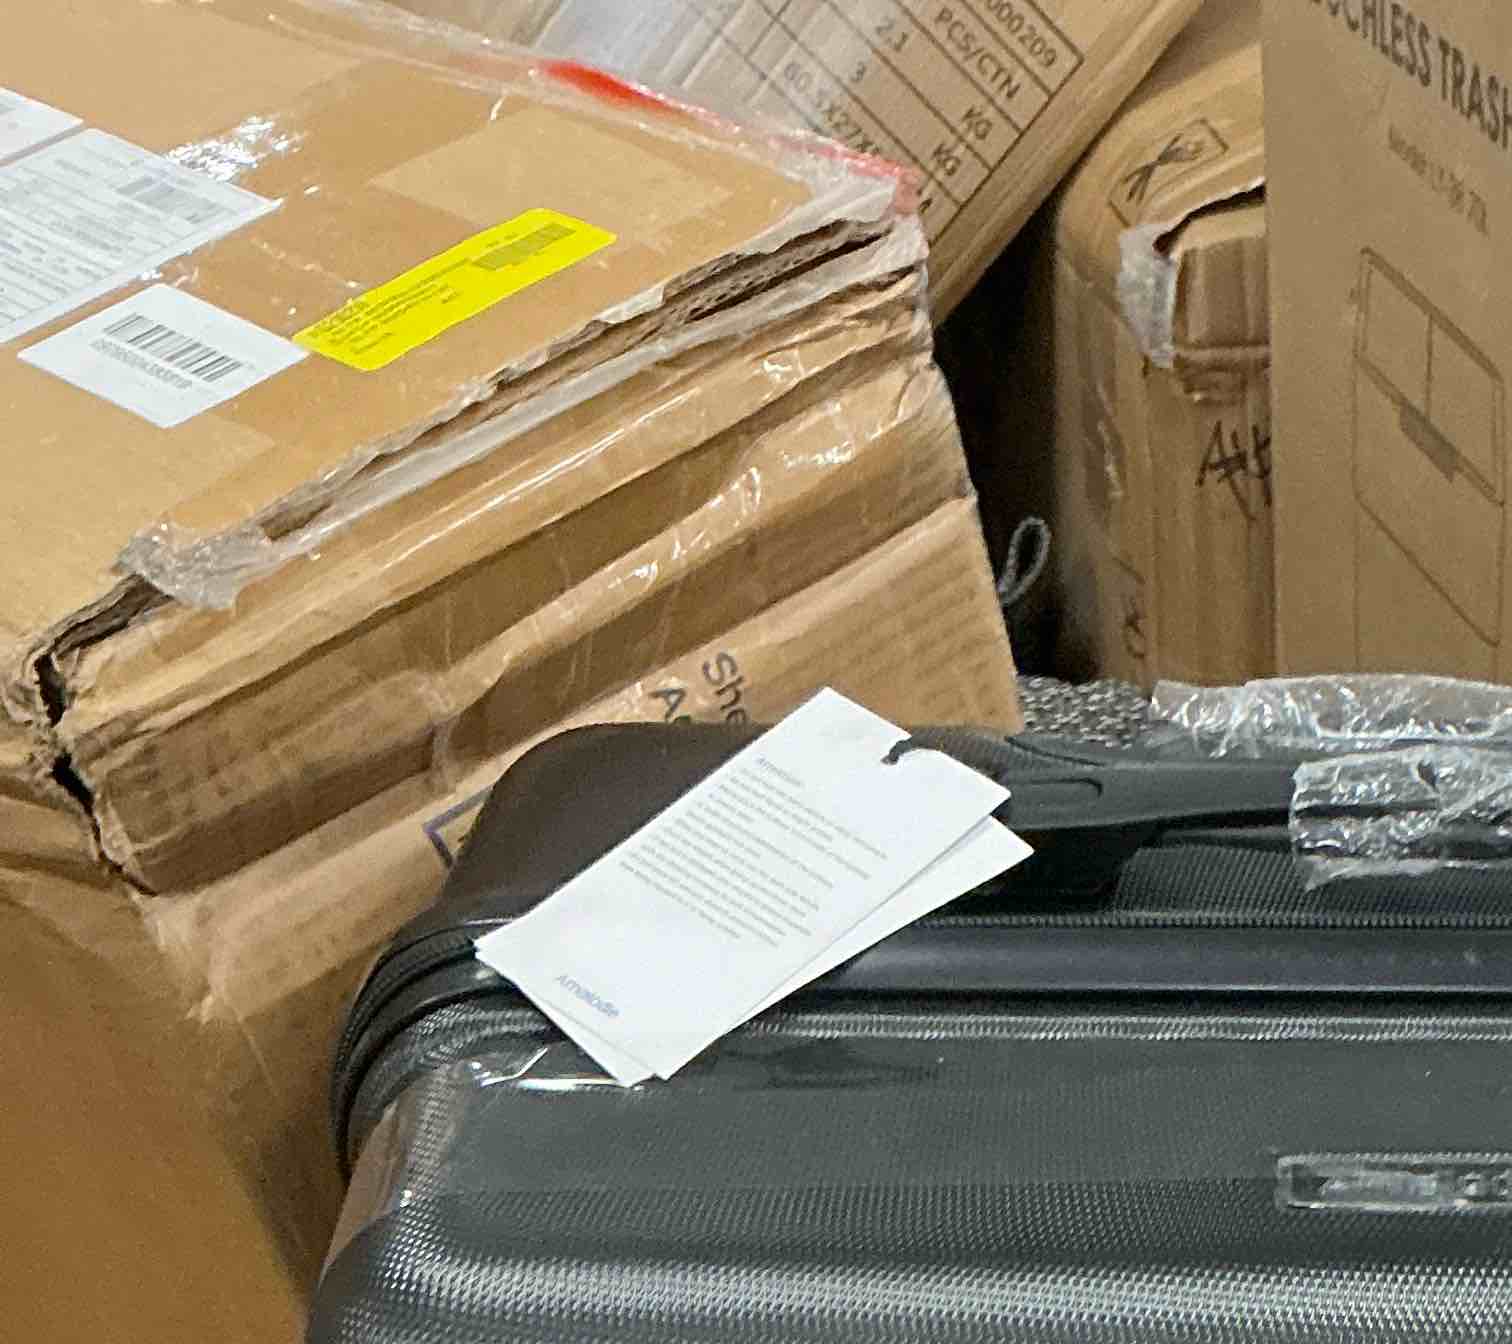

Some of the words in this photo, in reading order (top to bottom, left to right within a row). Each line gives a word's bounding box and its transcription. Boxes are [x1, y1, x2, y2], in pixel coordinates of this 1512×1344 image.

[933, 7, 1022, 101] PCS/CTN
[1314, 0, 1431, 87] CHLESS
[960, 105, 994, 142] KG
[931, 142, 962, 177] KG
